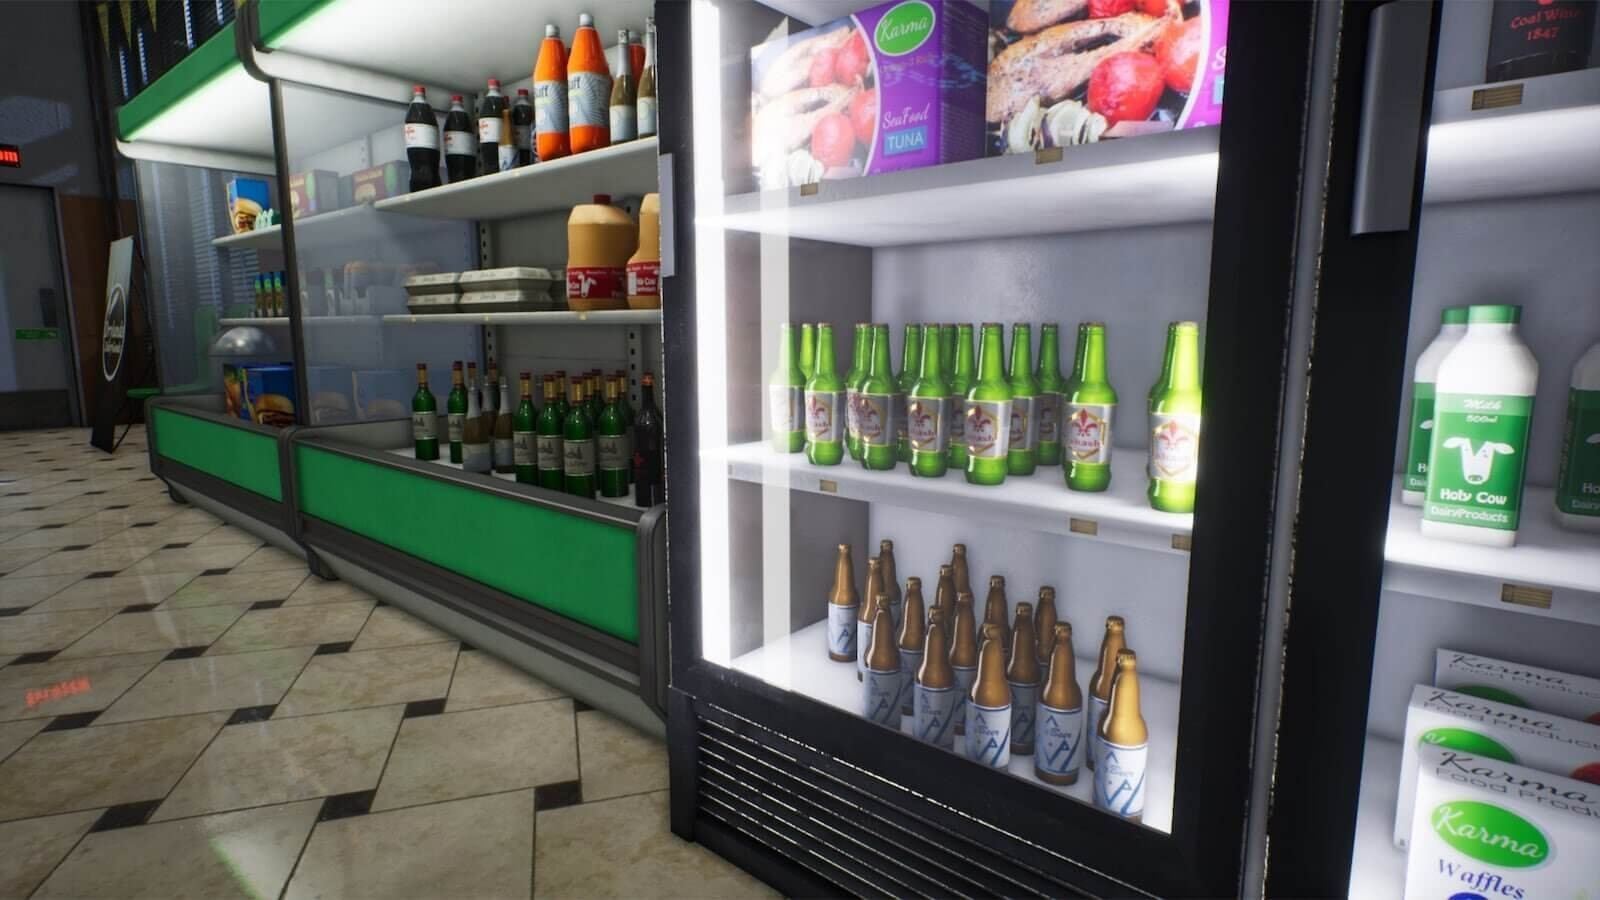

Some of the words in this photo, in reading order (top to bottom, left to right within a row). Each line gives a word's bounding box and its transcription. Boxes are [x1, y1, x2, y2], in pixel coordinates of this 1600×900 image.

[880, 16, 929, 42] Karma
[888, 131, 924, 150] TUNA
[1439, 487, 1473, 502] Holy
[1475, 491, 1508, 505] Cow
[1452, 654, 1569, 685] Karma
[1428, 691, 1559, 730] Karma
[1435, 767, 1508, 793] Food
[1440, 752, 1596, 804] Karma
[1435, 806, 1544, 858] Karma
[1438, 858, 1526, 900] Waffles
